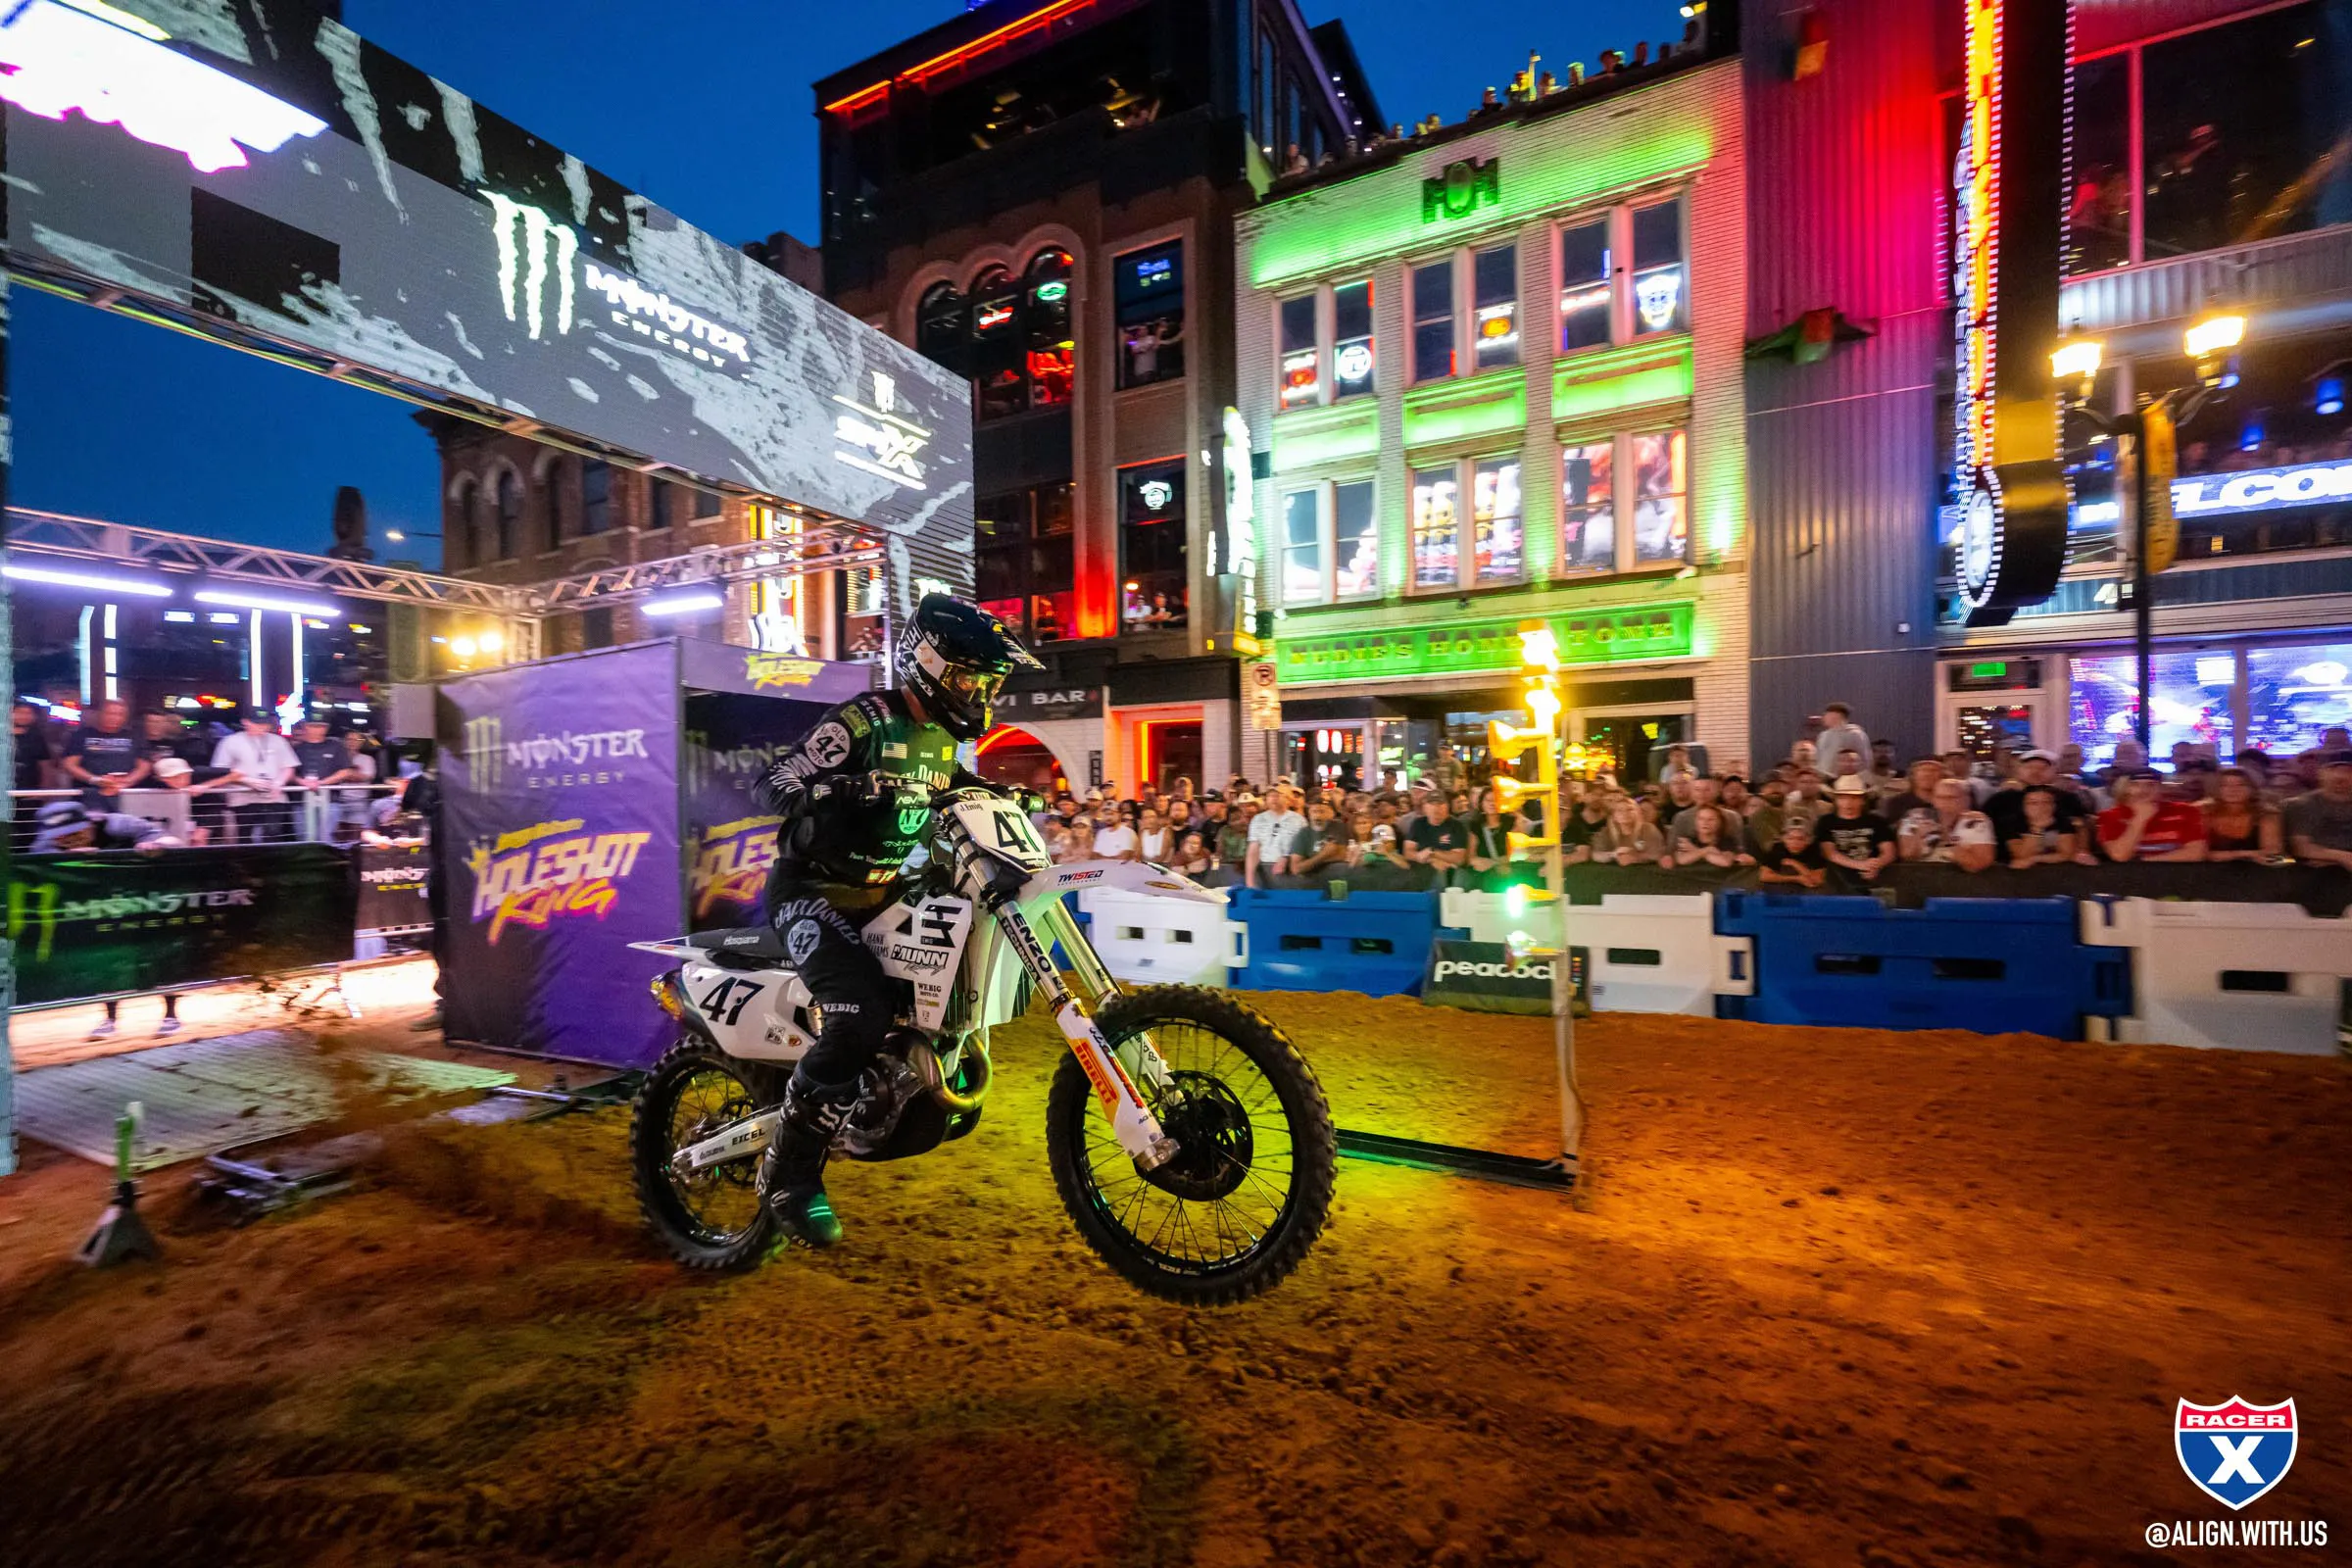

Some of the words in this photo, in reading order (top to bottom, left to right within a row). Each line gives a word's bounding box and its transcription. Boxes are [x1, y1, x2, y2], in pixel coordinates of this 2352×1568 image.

[584, 264, 751, 362] MONSTER
[611, 311, 726, 368] ENERGY
[1031, 690, 1087, 706] BAR
[507, 728, 649, 769] MONSTER
[816, 735, 848, 763] 47
[527, 770, 625, 788] ENERGY
[993, 809, 1041, 854] 47
[471, 832, 652, 917] HOLESHOT
[1057, 869, 1104, 883] TWISTED
[64, 888, 256, 921] MONSTER
[488, 877, 617, 943] KING
[792, 932, 819, 956] 47
[1001, 917, 1041, 983] TECHNICA
[1012, 912, 1053, 973] ENZO
[699, 976, 764, 1027] 47
[821, 1003, 860, 1014] WEBIG
